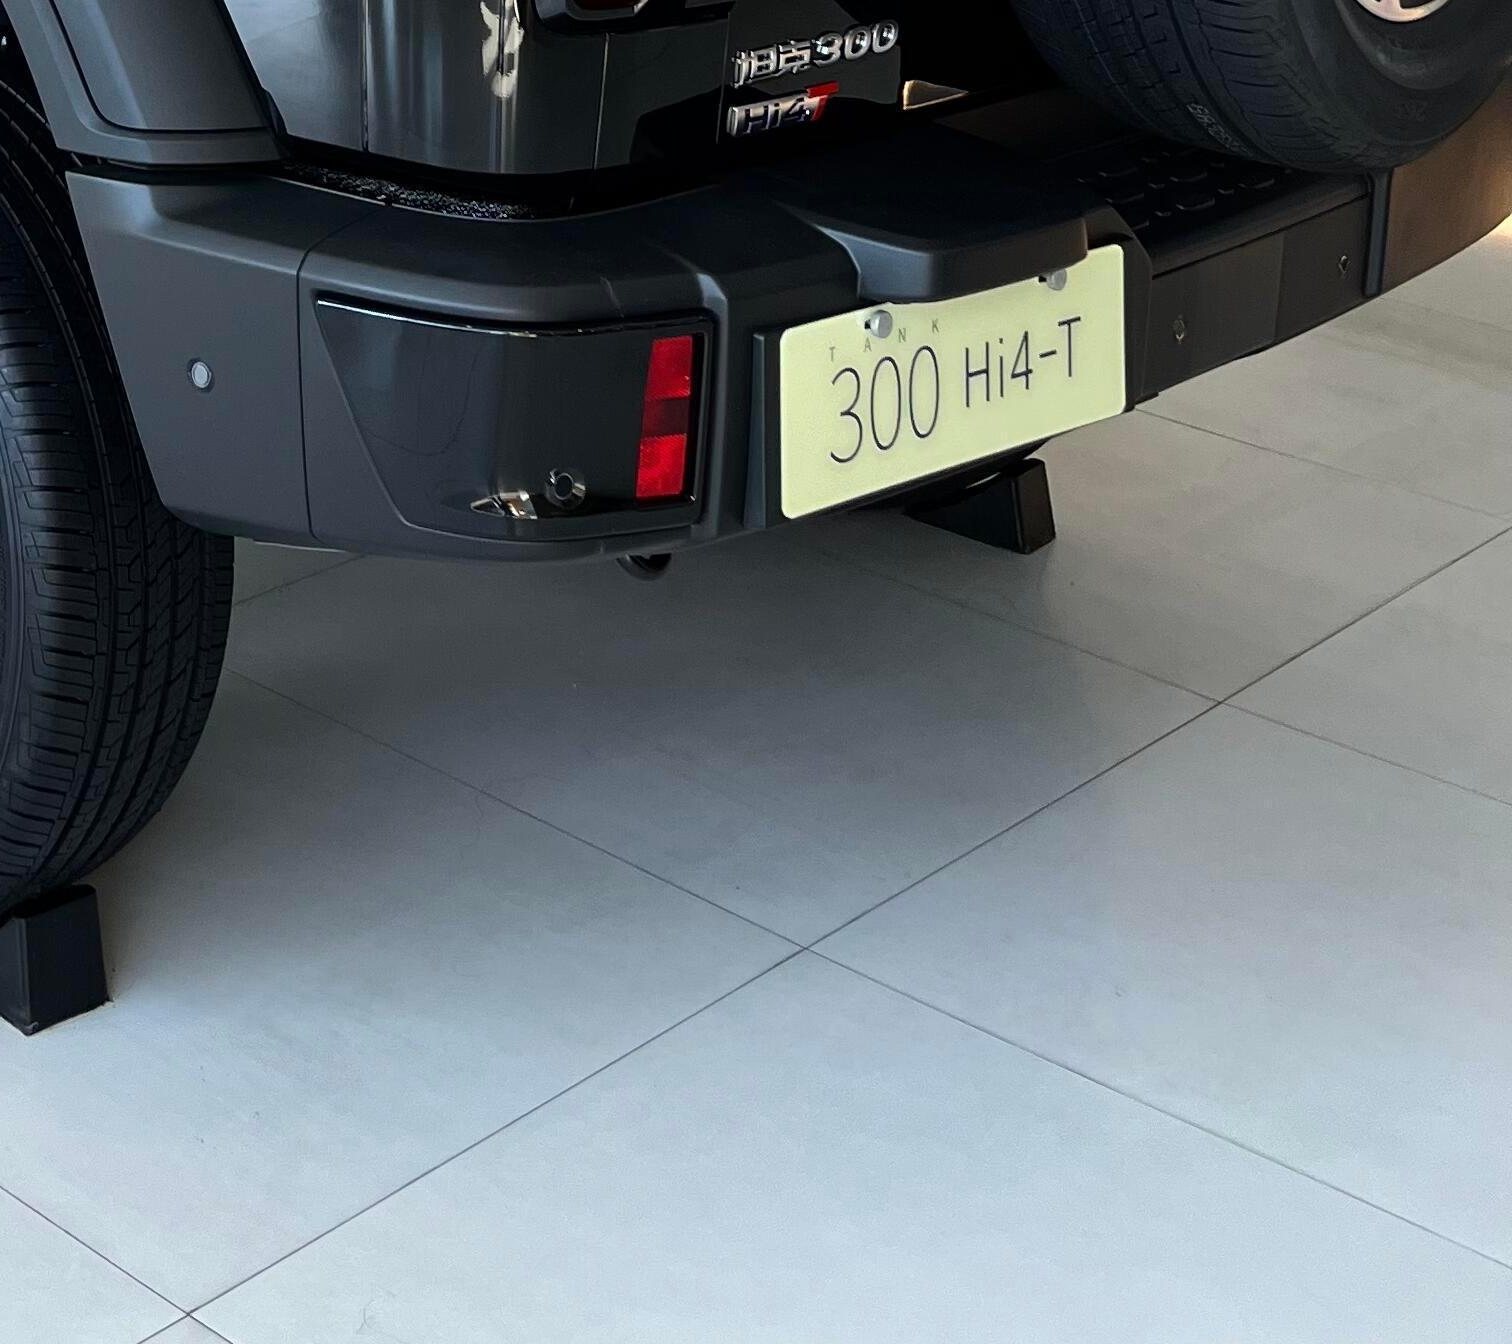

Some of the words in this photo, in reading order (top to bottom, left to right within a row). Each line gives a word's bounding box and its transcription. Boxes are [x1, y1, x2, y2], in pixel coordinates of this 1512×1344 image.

[732, 19, 900, 89] 坦克300
[830, 345, 940, 464] 300
[965, 315, 1082, 409] Hi4-T
